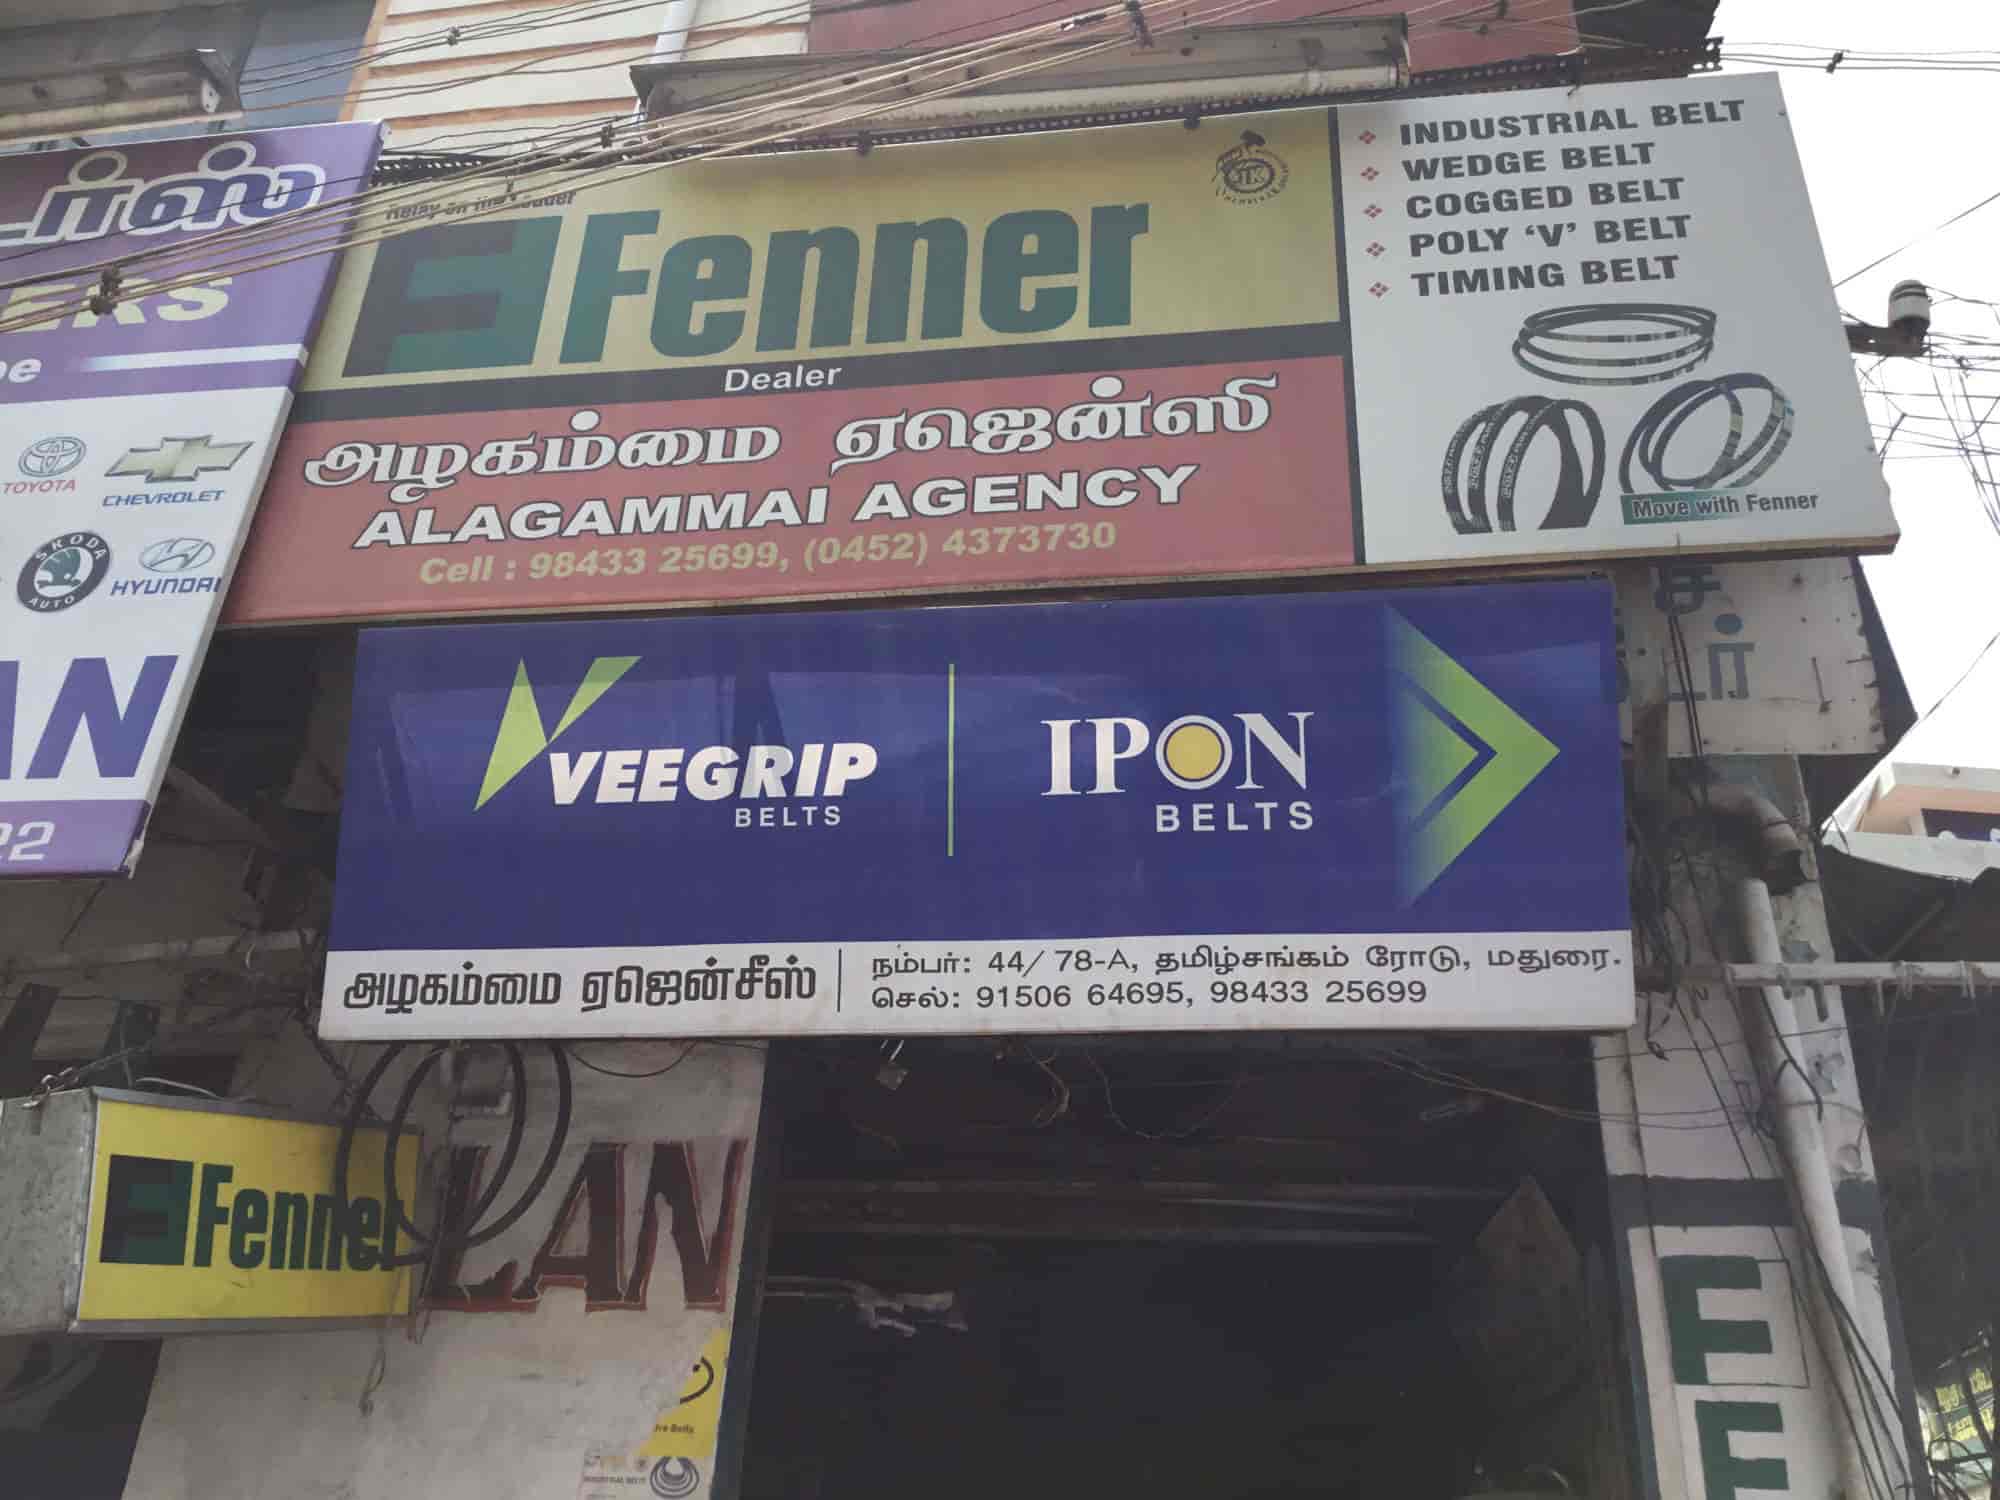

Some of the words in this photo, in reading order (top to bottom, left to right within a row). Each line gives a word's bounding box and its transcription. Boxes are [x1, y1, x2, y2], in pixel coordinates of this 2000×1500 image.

[1400, 108, 1638, 146] INDUSTRIAL
[1652, 99, 1745, 128] BELT
[1402, 149, 1546, 182] WEDGE
[1562, 141, 1656, 171] BELT
[1406, 184, 1573, 219] COGGED
[1589, 177, 1686, 206] BELT
[1409, 226, 1510, 258] POLY
[1594, 214, 1692, 244] BELT
[559, 203, 1149, 364] Fenner
[1411, 262, 1566, 297] TIMING
[1581, 254, 1680, 286] BELT
[724, 364, 843, 393] Dealer
[304, 409, 782, 504] அழகம்மை
[3, 479, 77, 494] TOYOTA
[102, 489, 225, 507] CHEVROLET
[351, 486, 829, 549] ALAGAMMAI
[853, 464, 1200, 522] AGENCY
[1633, 496, 1690, 520] Move
[1695, 494, 1739, 516] with
[1747, 492, 1819, 514] Fenner
[35, 533, 107, 560] SKODA
[419, 555, 493, 585] Cell
[528, 548, 646, 581] 98433
[658, 540, 788, 574] 25699,
[803, 528, 929, 573] (0452)
[942, 520, 1117, 557] 4373730
[28, 595, 75, 609] AUTO
[110, 576, 222, 598] HYUNDAI
[549, 742, 878, 805] VEEGRIP
[1040, 711, 1315, 796] IPON
[735, 805, 842, 828] BELTS
[1155, 800, 1314, 833] BELTS
[344, 960, 561, 1014] அழகம்மை
[581, 954, 817, 1012] ஏஜென்சீஸ்
[871, 985, 960, 1009] செல்:
[976, 985, 1072, 1008] 91506
[1087, 981, 1193, 1008] 64695,
[1210, 981, 1309, 1004] 98433
[1325, 980, 1428, 1003] 25699
